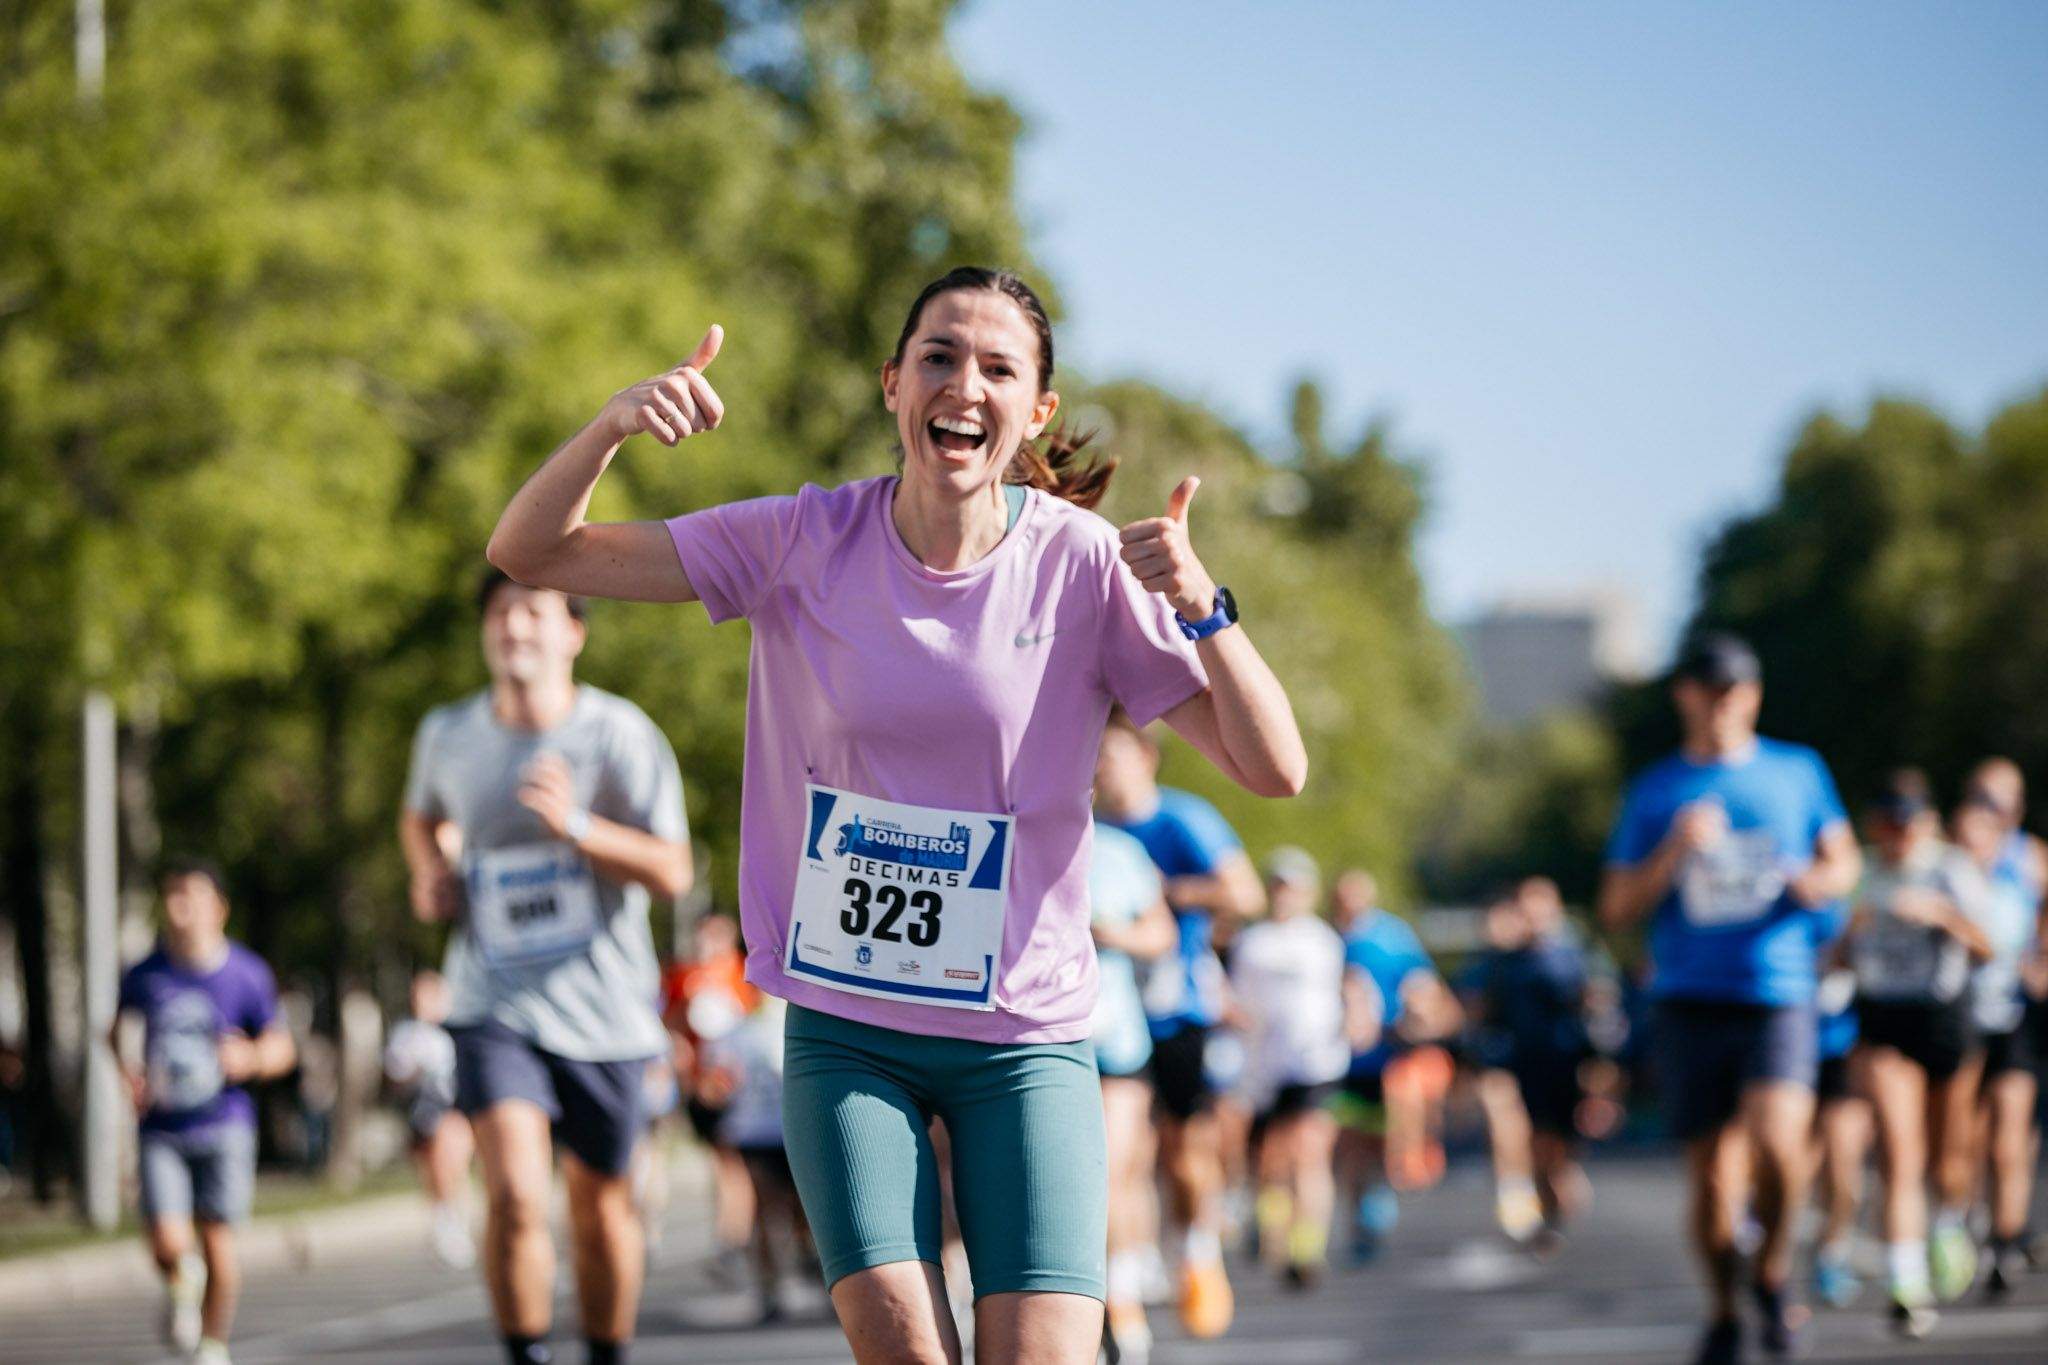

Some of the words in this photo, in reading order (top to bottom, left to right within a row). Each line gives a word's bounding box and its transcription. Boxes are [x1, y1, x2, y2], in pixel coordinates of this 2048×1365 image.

[863, 826, 966, 855] BOMBEROS
[850, 857, 959, 887] DECIMAS
[840, 878, 943, 947] 323
